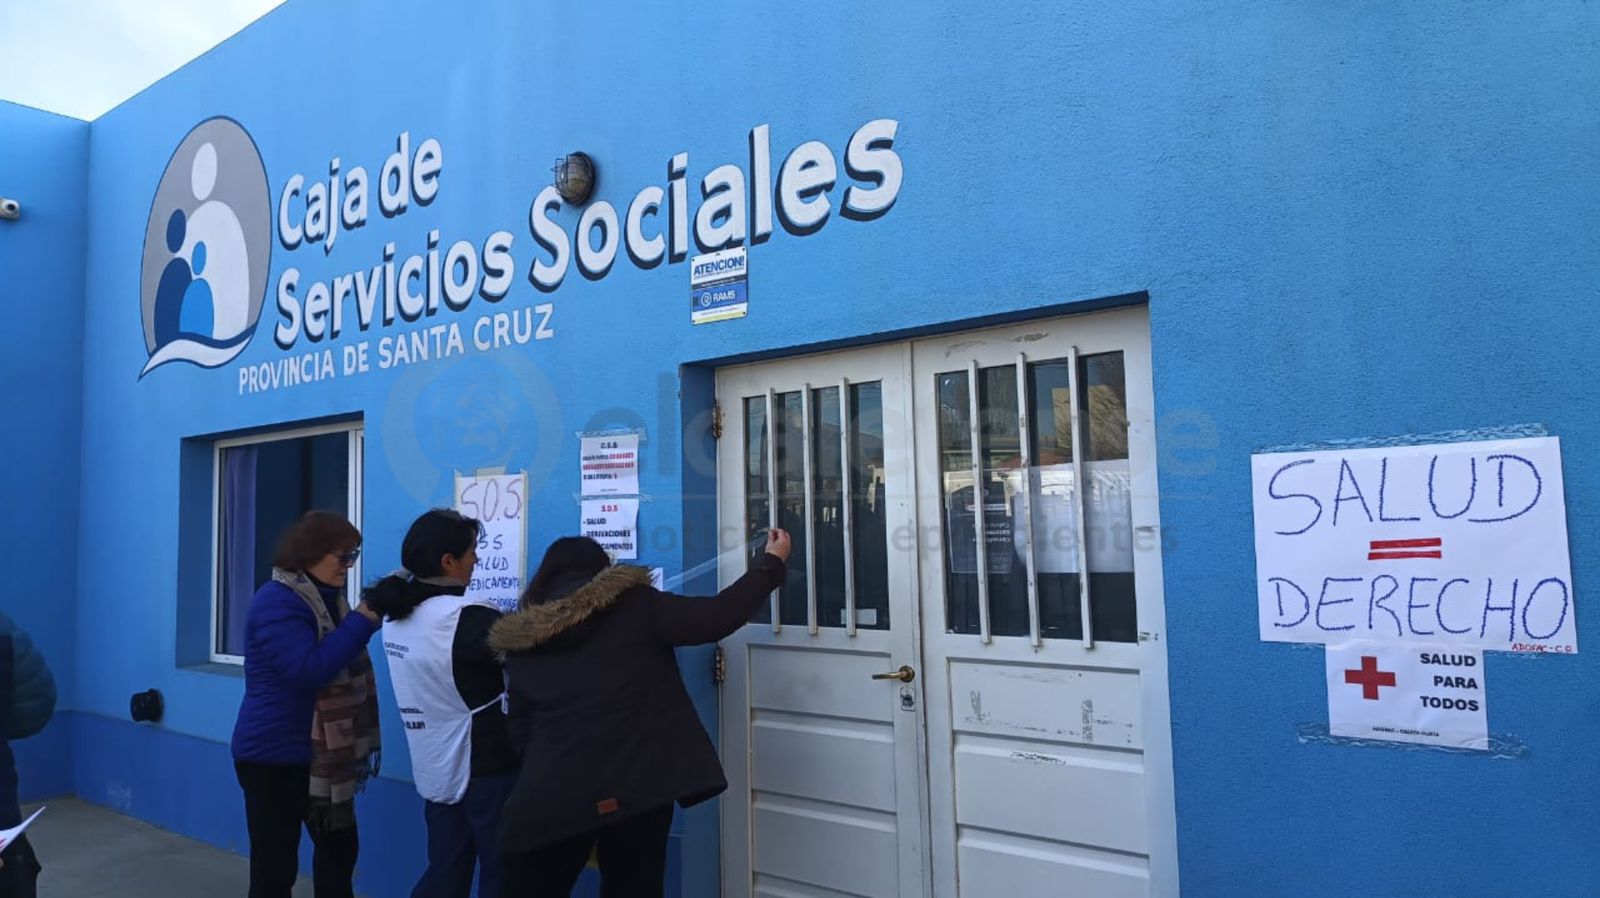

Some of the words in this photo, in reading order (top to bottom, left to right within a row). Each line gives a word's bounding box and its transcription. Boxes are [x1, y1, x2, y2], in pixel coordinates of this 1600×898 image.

[278, 157, 368, 256] Caja
[378, 131, 443, 219] de
[274, 230, 516, 349] Servicios
[528, 118, 904, 293] Sociales
[693, 255, 745, 275] ATENCION!
[238, 349, 336, 396] PROVINCIA
[343, 341, 370, 376] DE
[378, 322, 465, 370] SANTA
[473, 302, 555, 351] CRUZ
[1268, 454, 1542, 536] SALUD
[476, 556, 509, 571] ALUD
[1267, 574, 1568, 642] DERECHO
[1419, 652, 1477, 667] SALUD
[1419, 695, 1480, 712] TODOS
[1433, 675, 1479, 690] PARA
